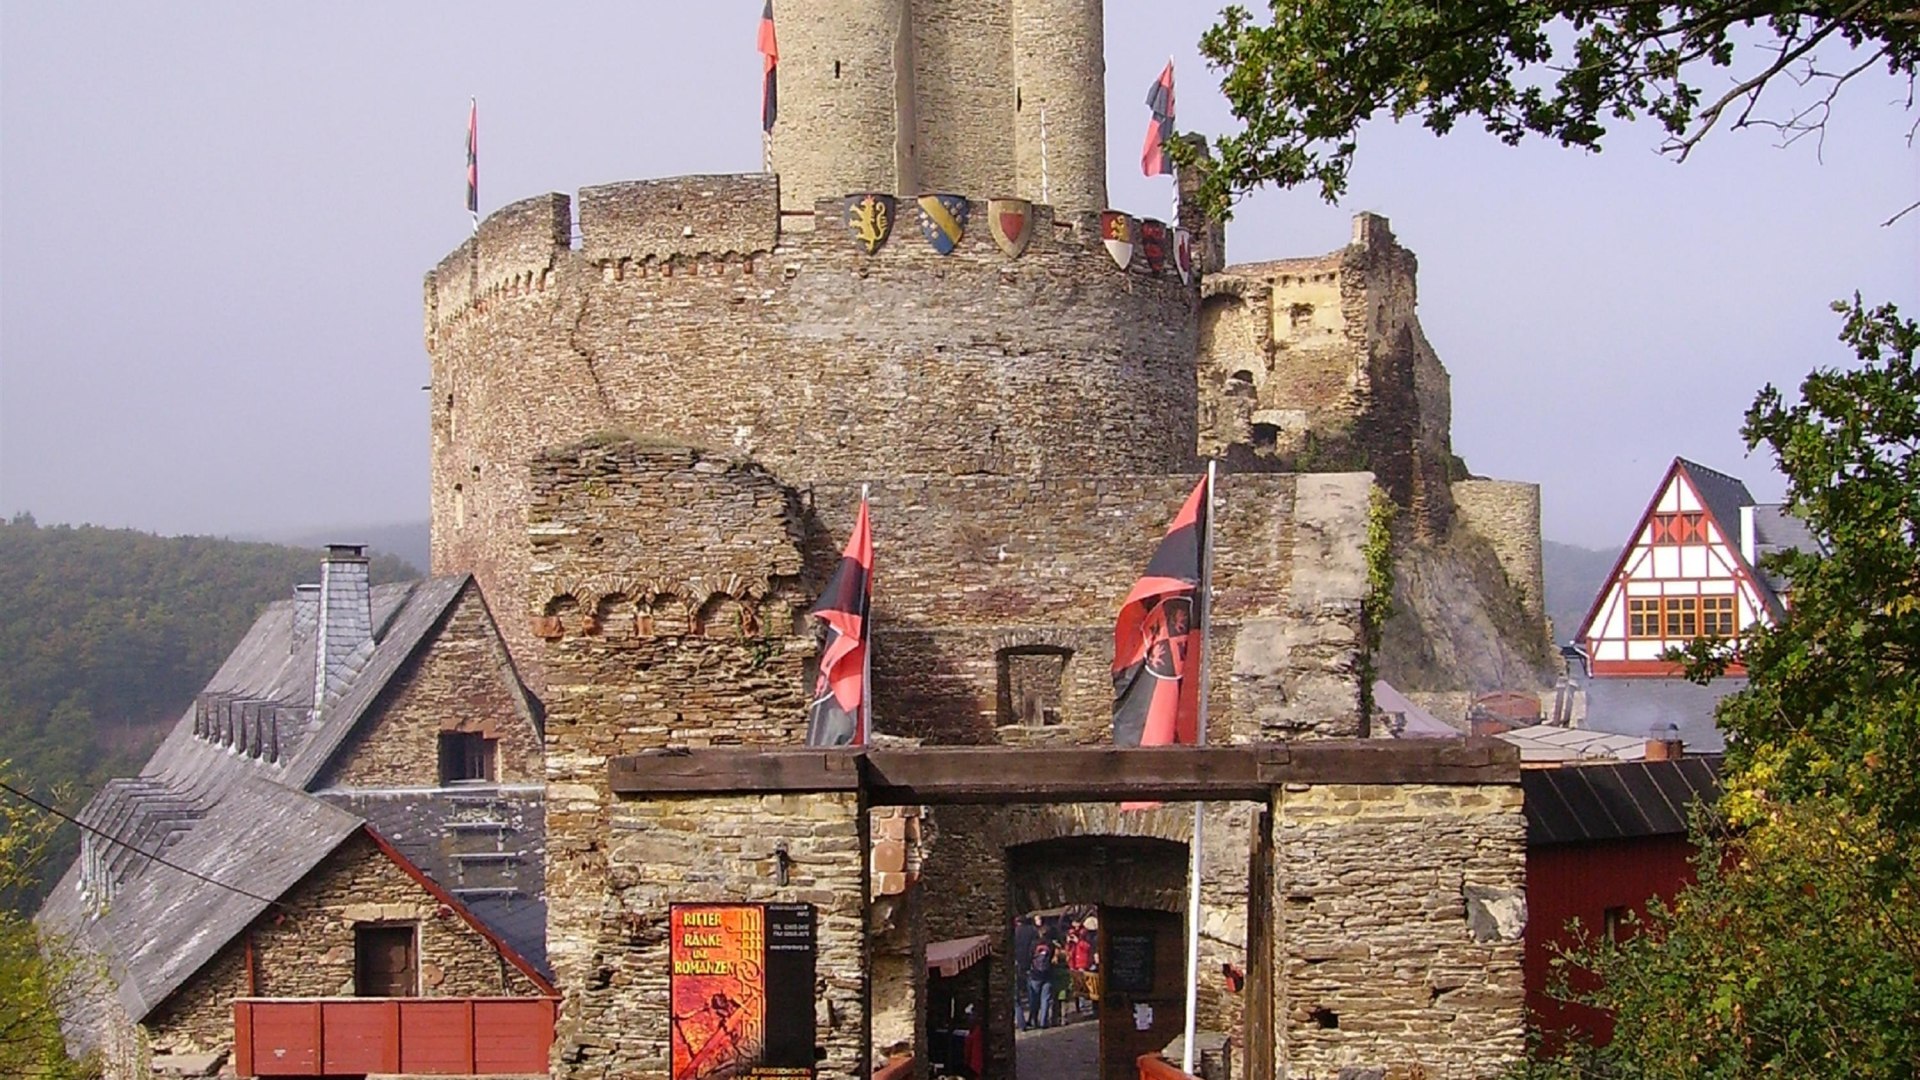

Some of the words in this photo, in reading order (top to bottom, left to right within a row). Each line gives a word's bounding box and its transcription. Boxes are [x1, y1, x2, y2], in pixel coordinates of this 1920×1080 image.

[683, 912, 722, 926] RITTER
[684, 930, 722, 946] RÄNKE
[674, 961, 735, 975] ROMANZEN
